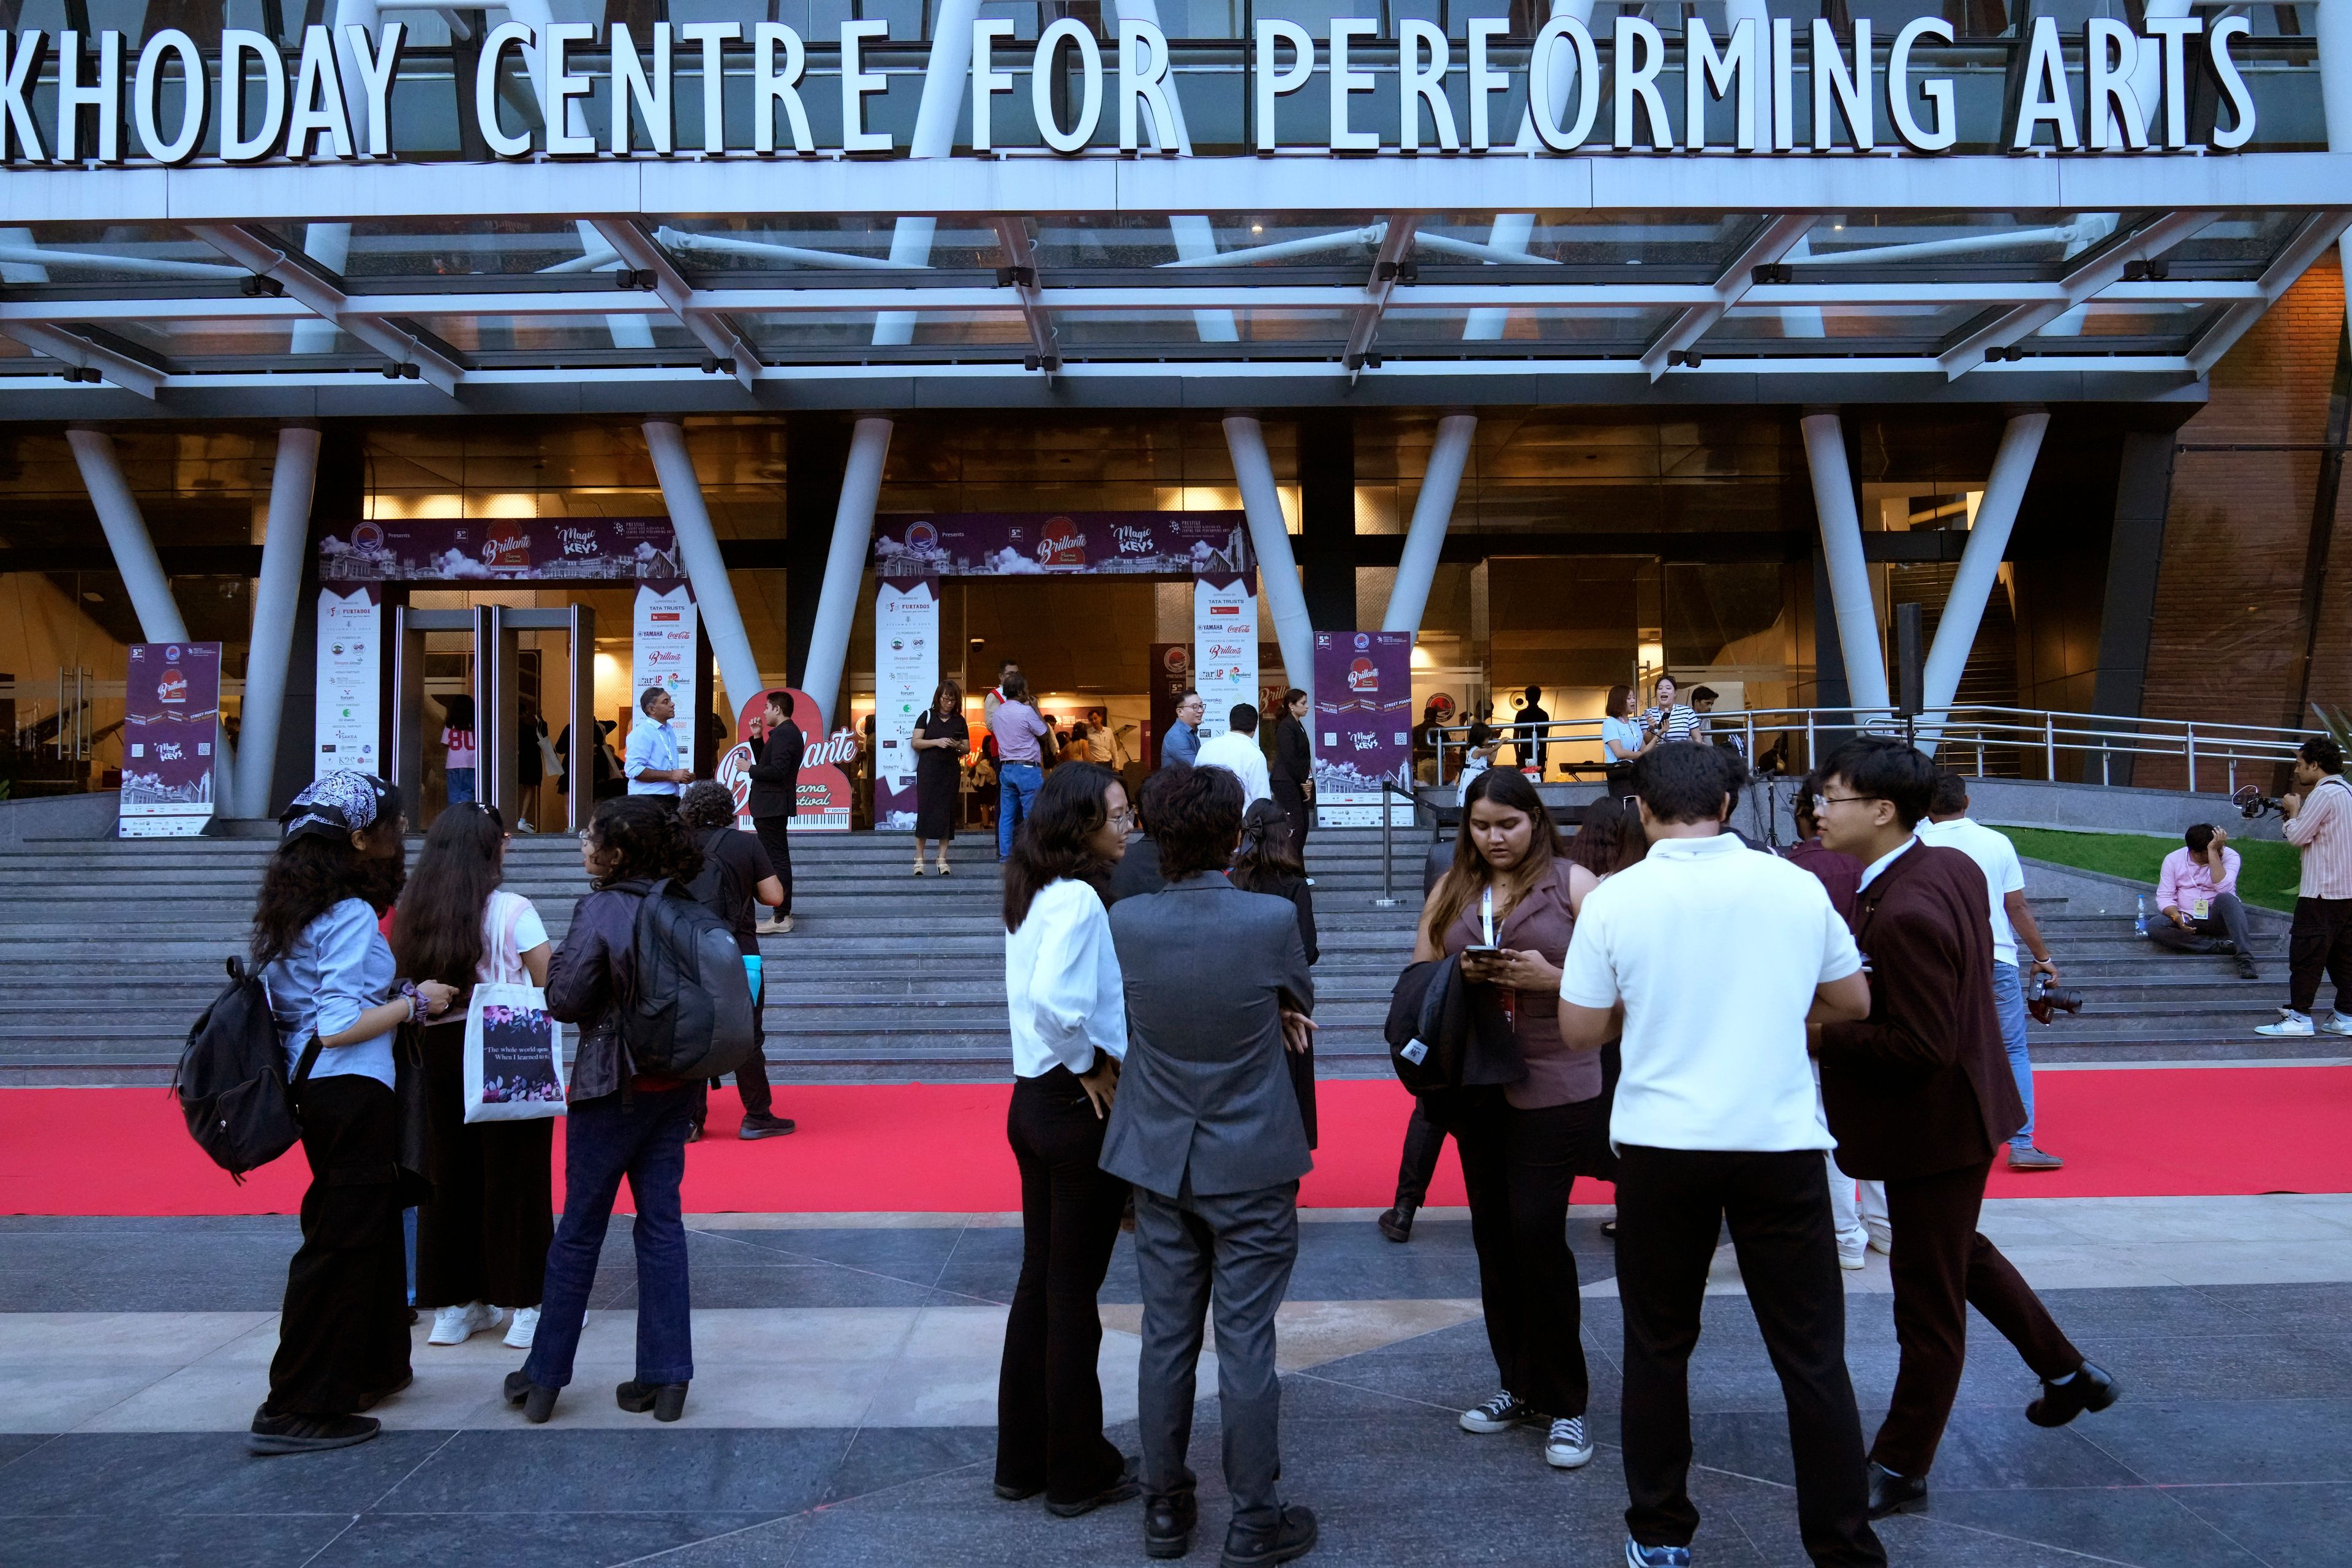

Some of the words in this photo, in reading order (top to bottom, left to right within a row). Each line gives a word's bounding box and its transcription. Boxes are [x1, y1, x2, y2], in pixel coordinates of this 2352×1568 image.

[0, 21, 407, 165] KHODAY
[475, 18, 895, 156] CENTRE
[971, 17, 1180, 155] FOR
[1256, 15, 1956, 154] PERFORMING
[2008, 15, 2256, 152] ARTS
[558, 527, 596, 544] Magic
[1114, 526, 1152, 542] Magic
[482, 535, 531, 565] Brillante
[564, 541, 598, 555] KEYS
[1037, 534, 1086, 565] Brillante
[1119, 538, 1154, 553] KEYS
[649, 651, 682, 666] Brillante
[1210, 644, 1242, 660] Brillante
[1348, 668, 1379, 688] Brillante
[157, 679, 188, 700] Brillante
[448, 728, 475, 751] 80
[1350, 732, 1376, 742] Magic
[1355, 739, 1378, 751] KEYS
[156, 743, 181, 753] Magic
[160, 750, 183, 761] KEYS
[796, 783, 827, 793] iano
